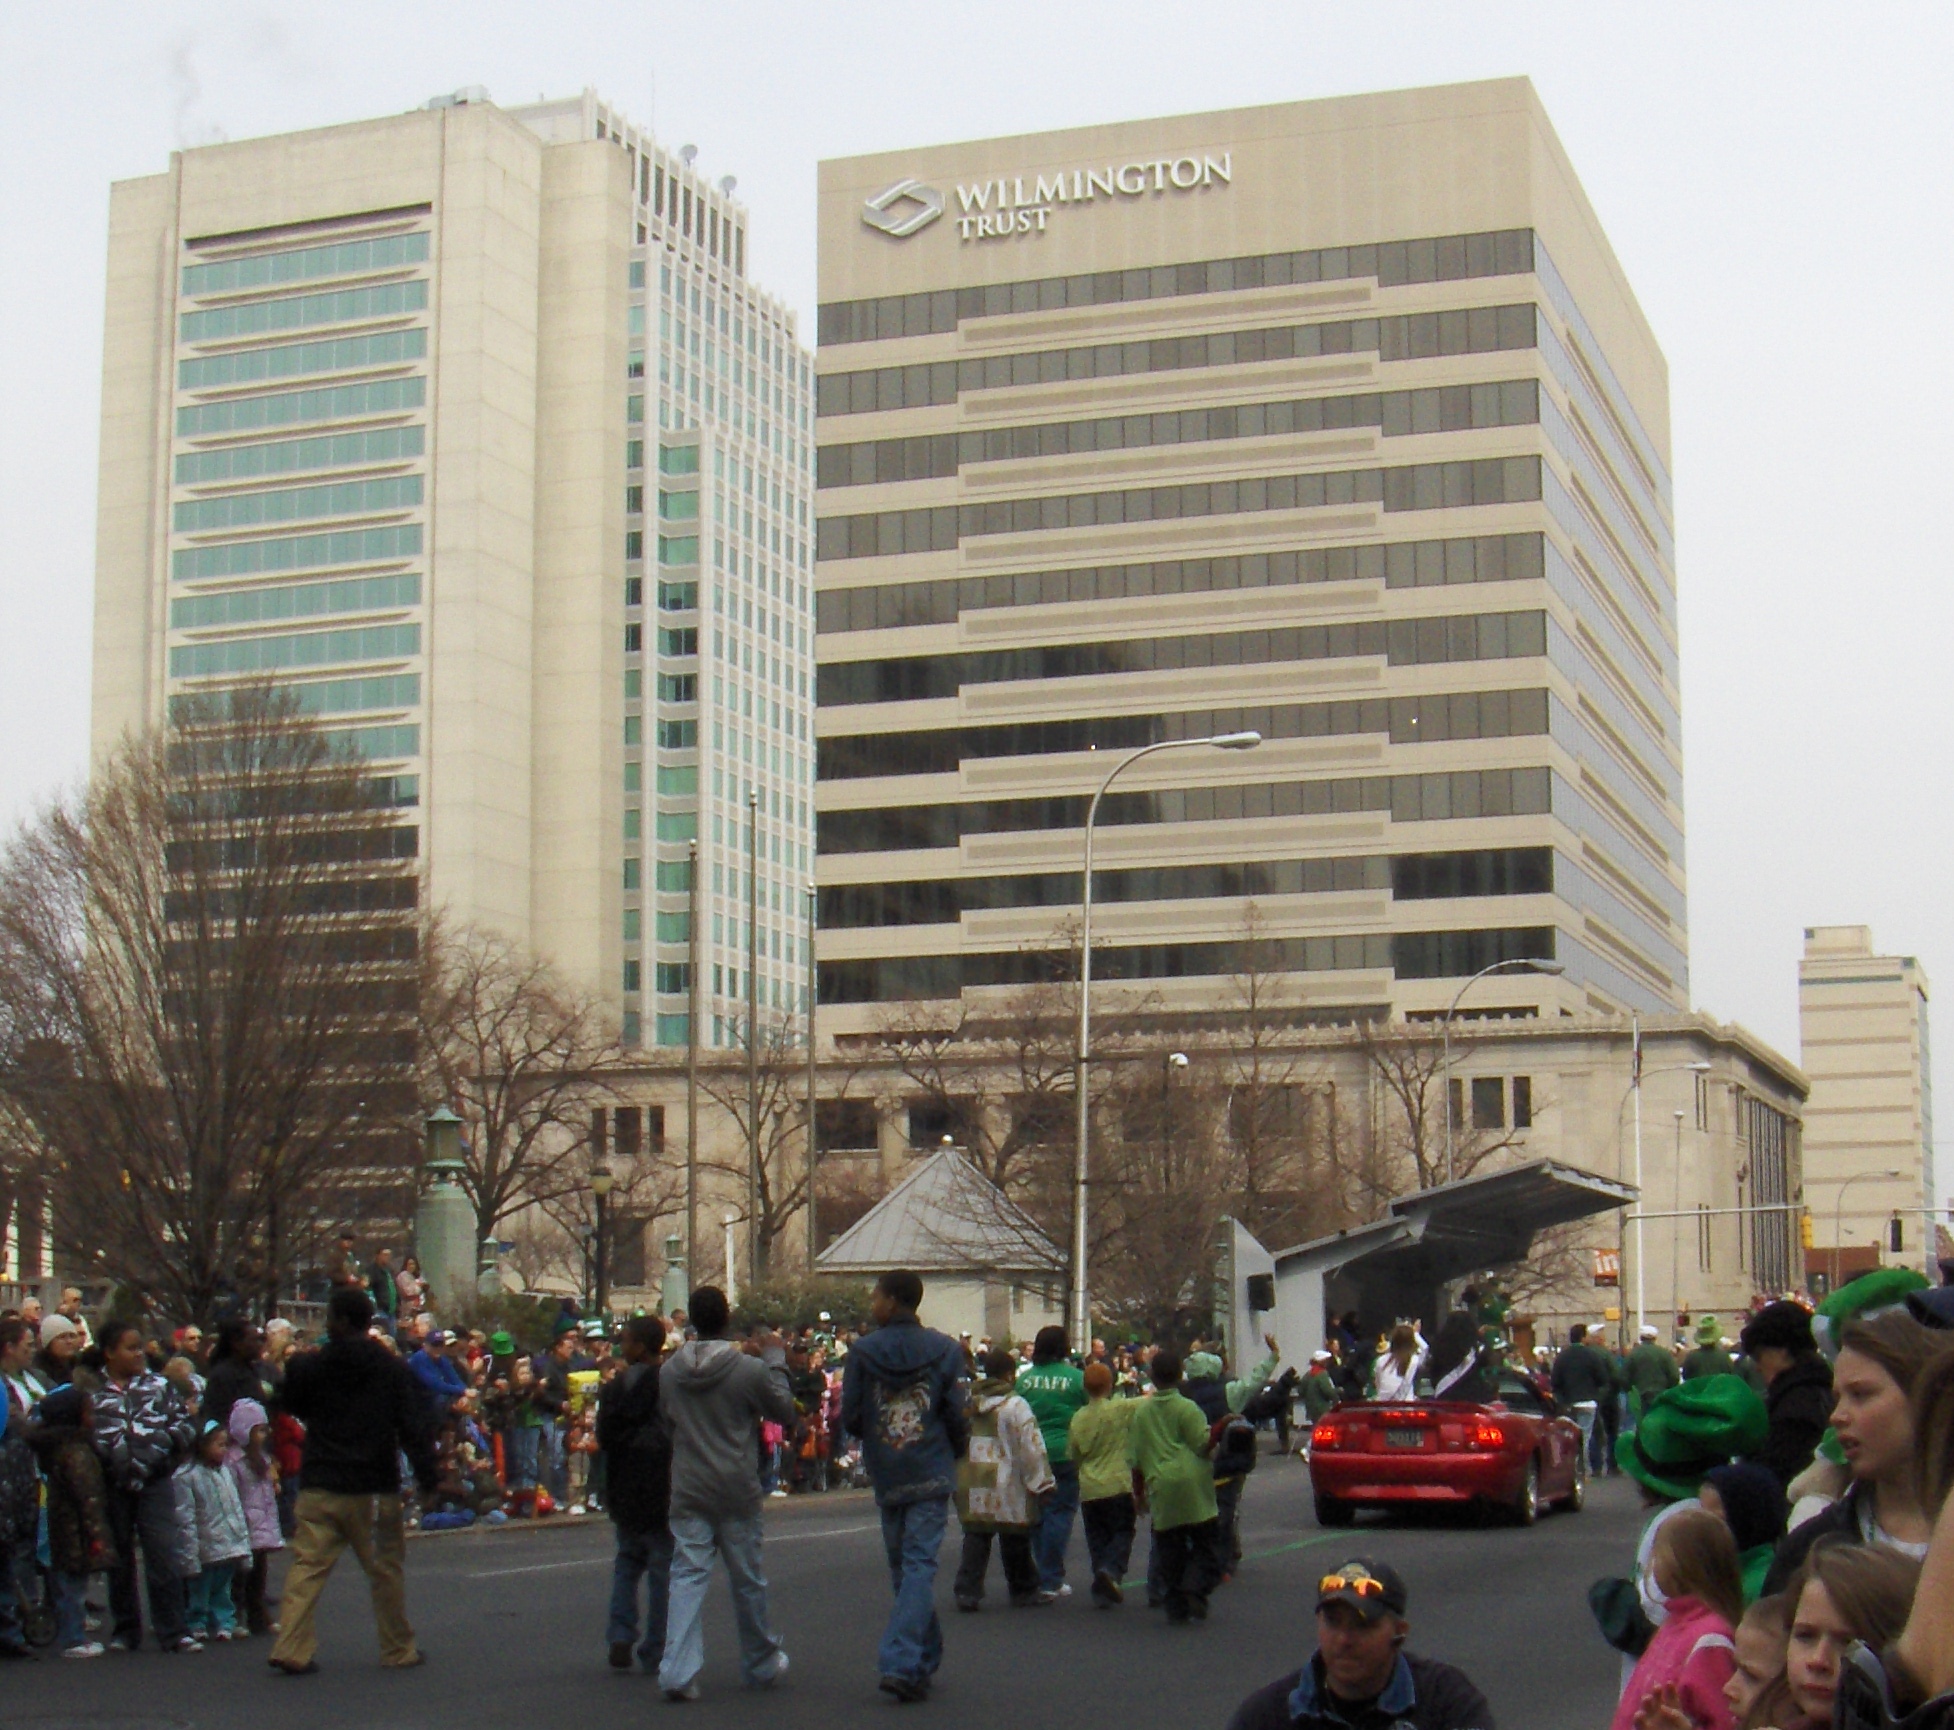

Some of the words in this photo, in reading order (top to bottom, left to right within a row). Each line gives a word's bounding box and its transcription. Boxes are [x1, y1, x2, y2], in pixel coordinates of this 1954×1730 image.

[955, 153, 1233, 211] WILMINGTON
[957, 208, 1051, 241] TRUST
[1022, 1375, 1073, 1391] STAFF
